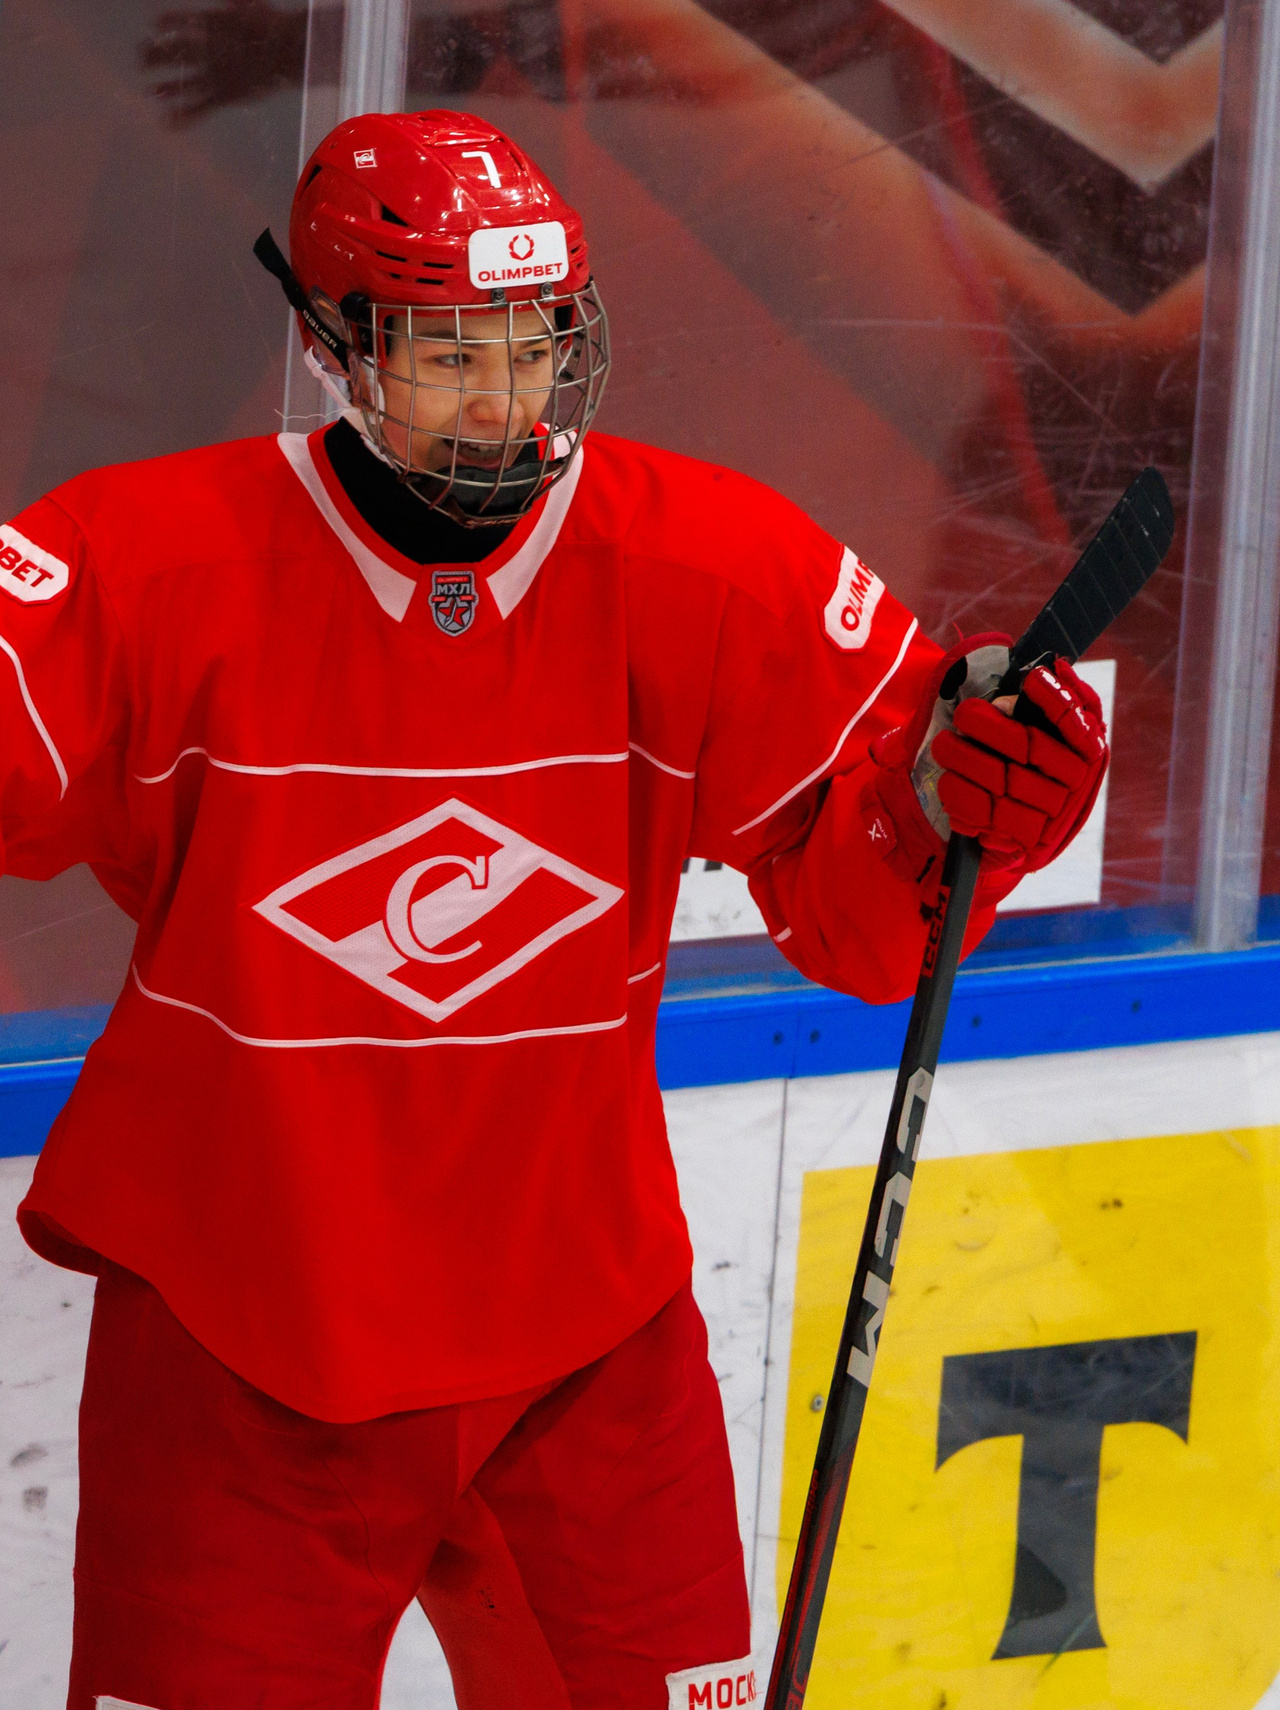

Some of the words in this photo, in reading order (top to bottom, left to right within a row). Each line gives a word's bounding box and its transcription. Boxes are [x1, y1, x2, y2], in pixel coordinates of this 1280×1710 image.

[462, 151, 502, 188] 7
[478, 262, 563, 282] OLIMPBET
[437, 584, 471, 595] МХЛ
[846, 1066, 934, 1388] CCM
